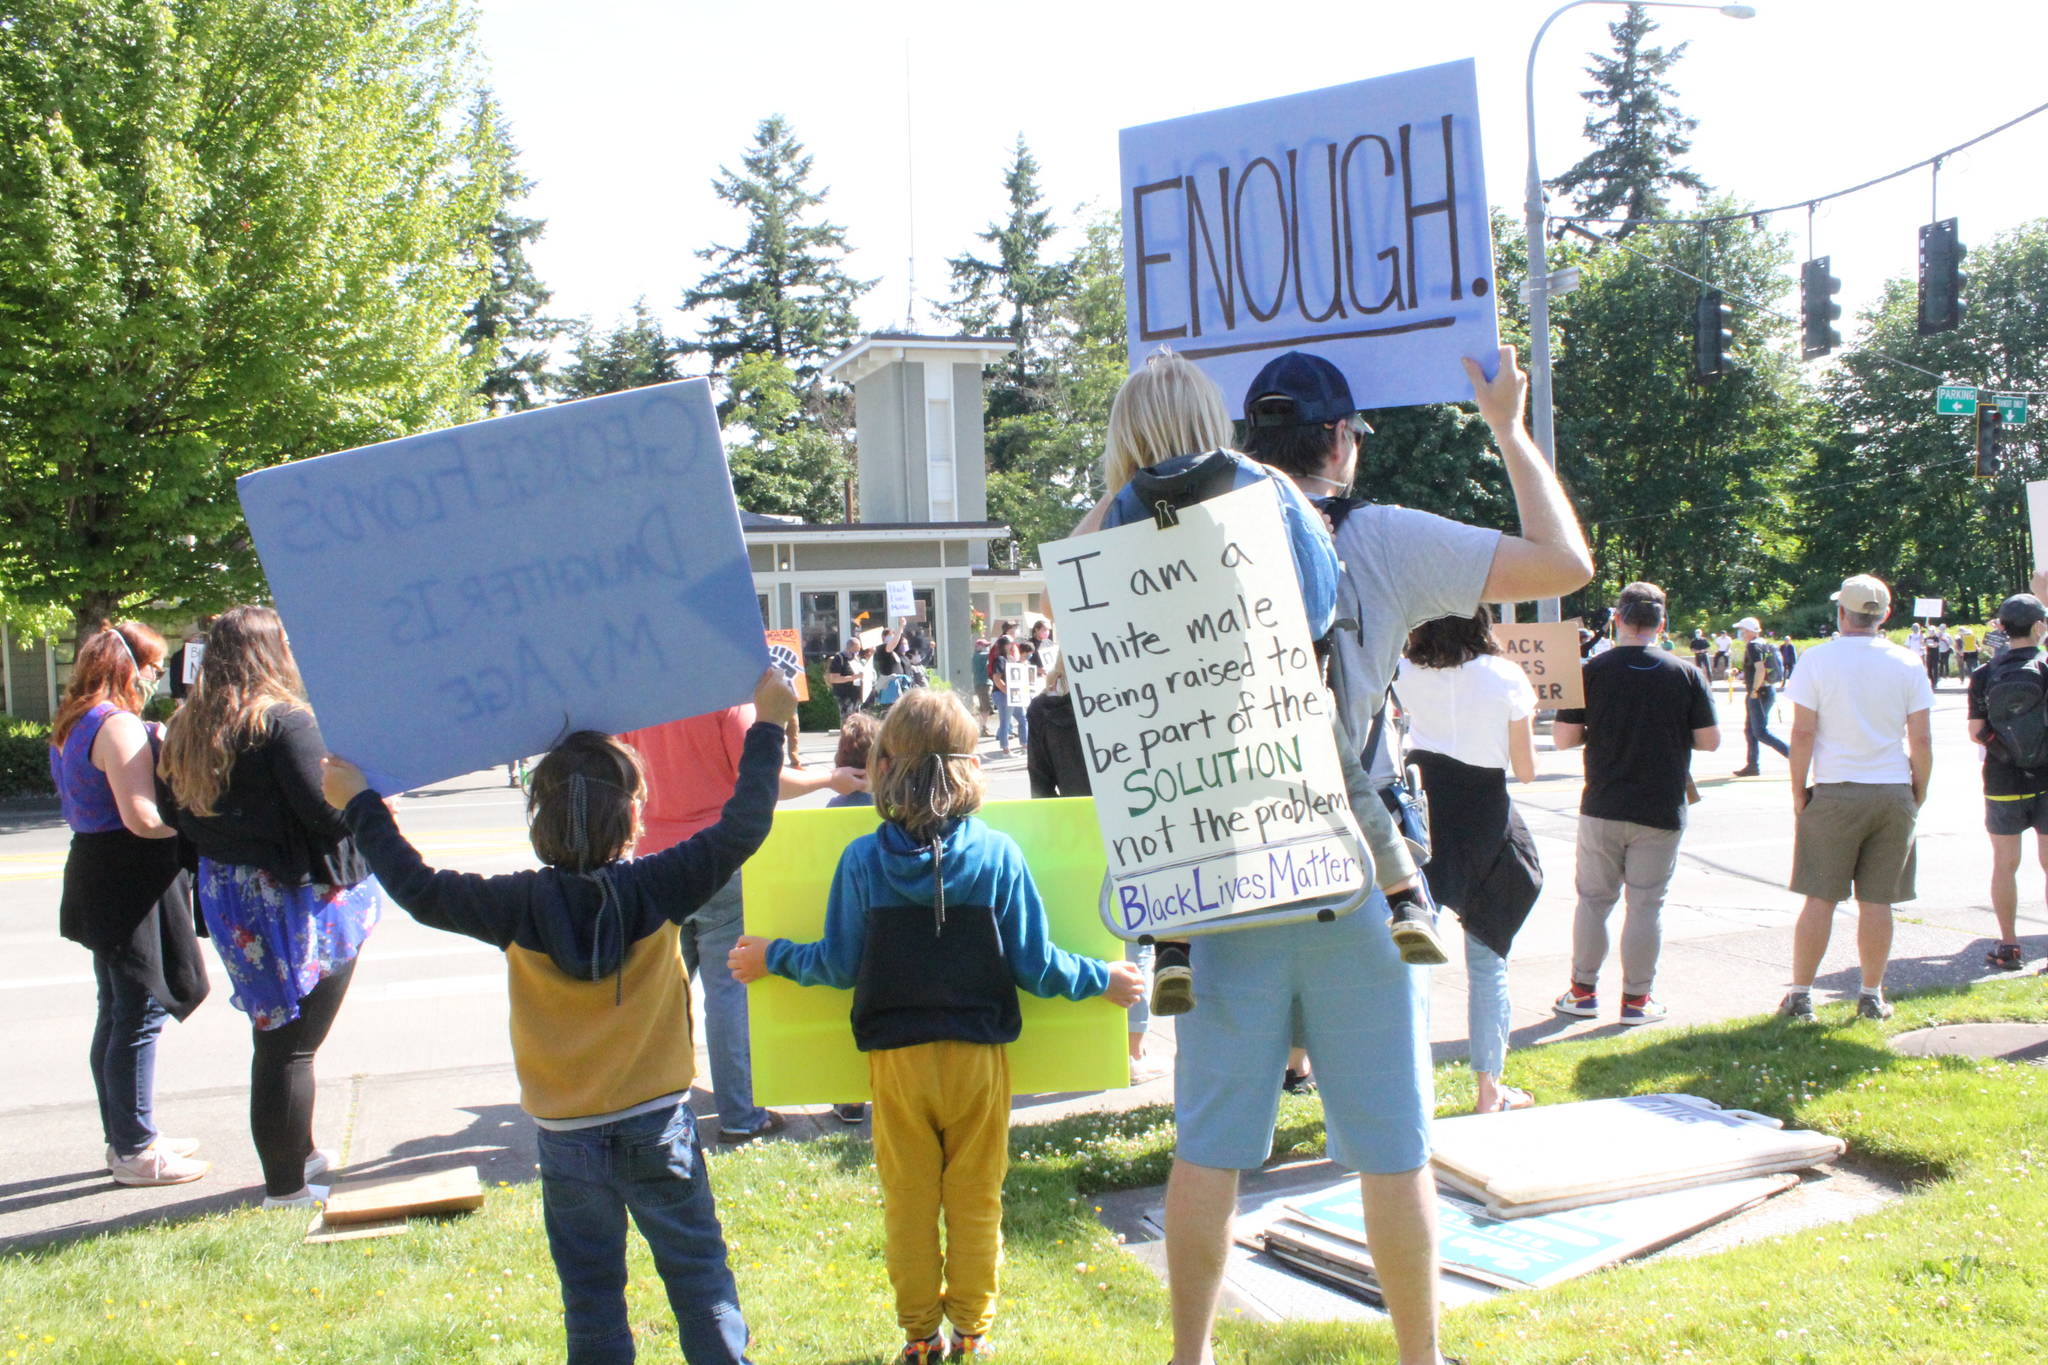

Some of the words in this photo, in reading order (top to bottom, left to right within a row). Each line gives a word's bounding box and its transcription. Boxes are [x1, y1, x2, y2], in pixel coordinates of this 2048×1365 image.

[1133, 114, 1488, 342] ENOUGH.
[1940, 389, 1975, 399] PARKING
[1058, 550, 1110, 613] I
[1130, 559, 1198, 597] am
[1221, 541, 1253, 568] a
[1067, 622, 1170, 673] white
[1186, 593, 1278, 644] male
[1501, 639, 1545, 654] ACK
[1075, 678, 1159, 719] being
[1165, 642, 1256, 694] raised
[1267, 635, 1308, 676] to
[1086, 732, 1132, 774] be
[1138, 709, 1216, 769] part
[1227, 691, 1256, 735] of
[1263, 685, 1324, 729] the
[1123, 734, 1303, 818] SOLUTION
[1112, 815, 1177, 867] not
[1190, 806, 1250, 846] the
[1255, 780, 1349, 844] problem
[1119, 884, 1200, 931] Black
[1192, 867, 1267, 913] Lives
[1268, 846, 1357, 899] Matter
